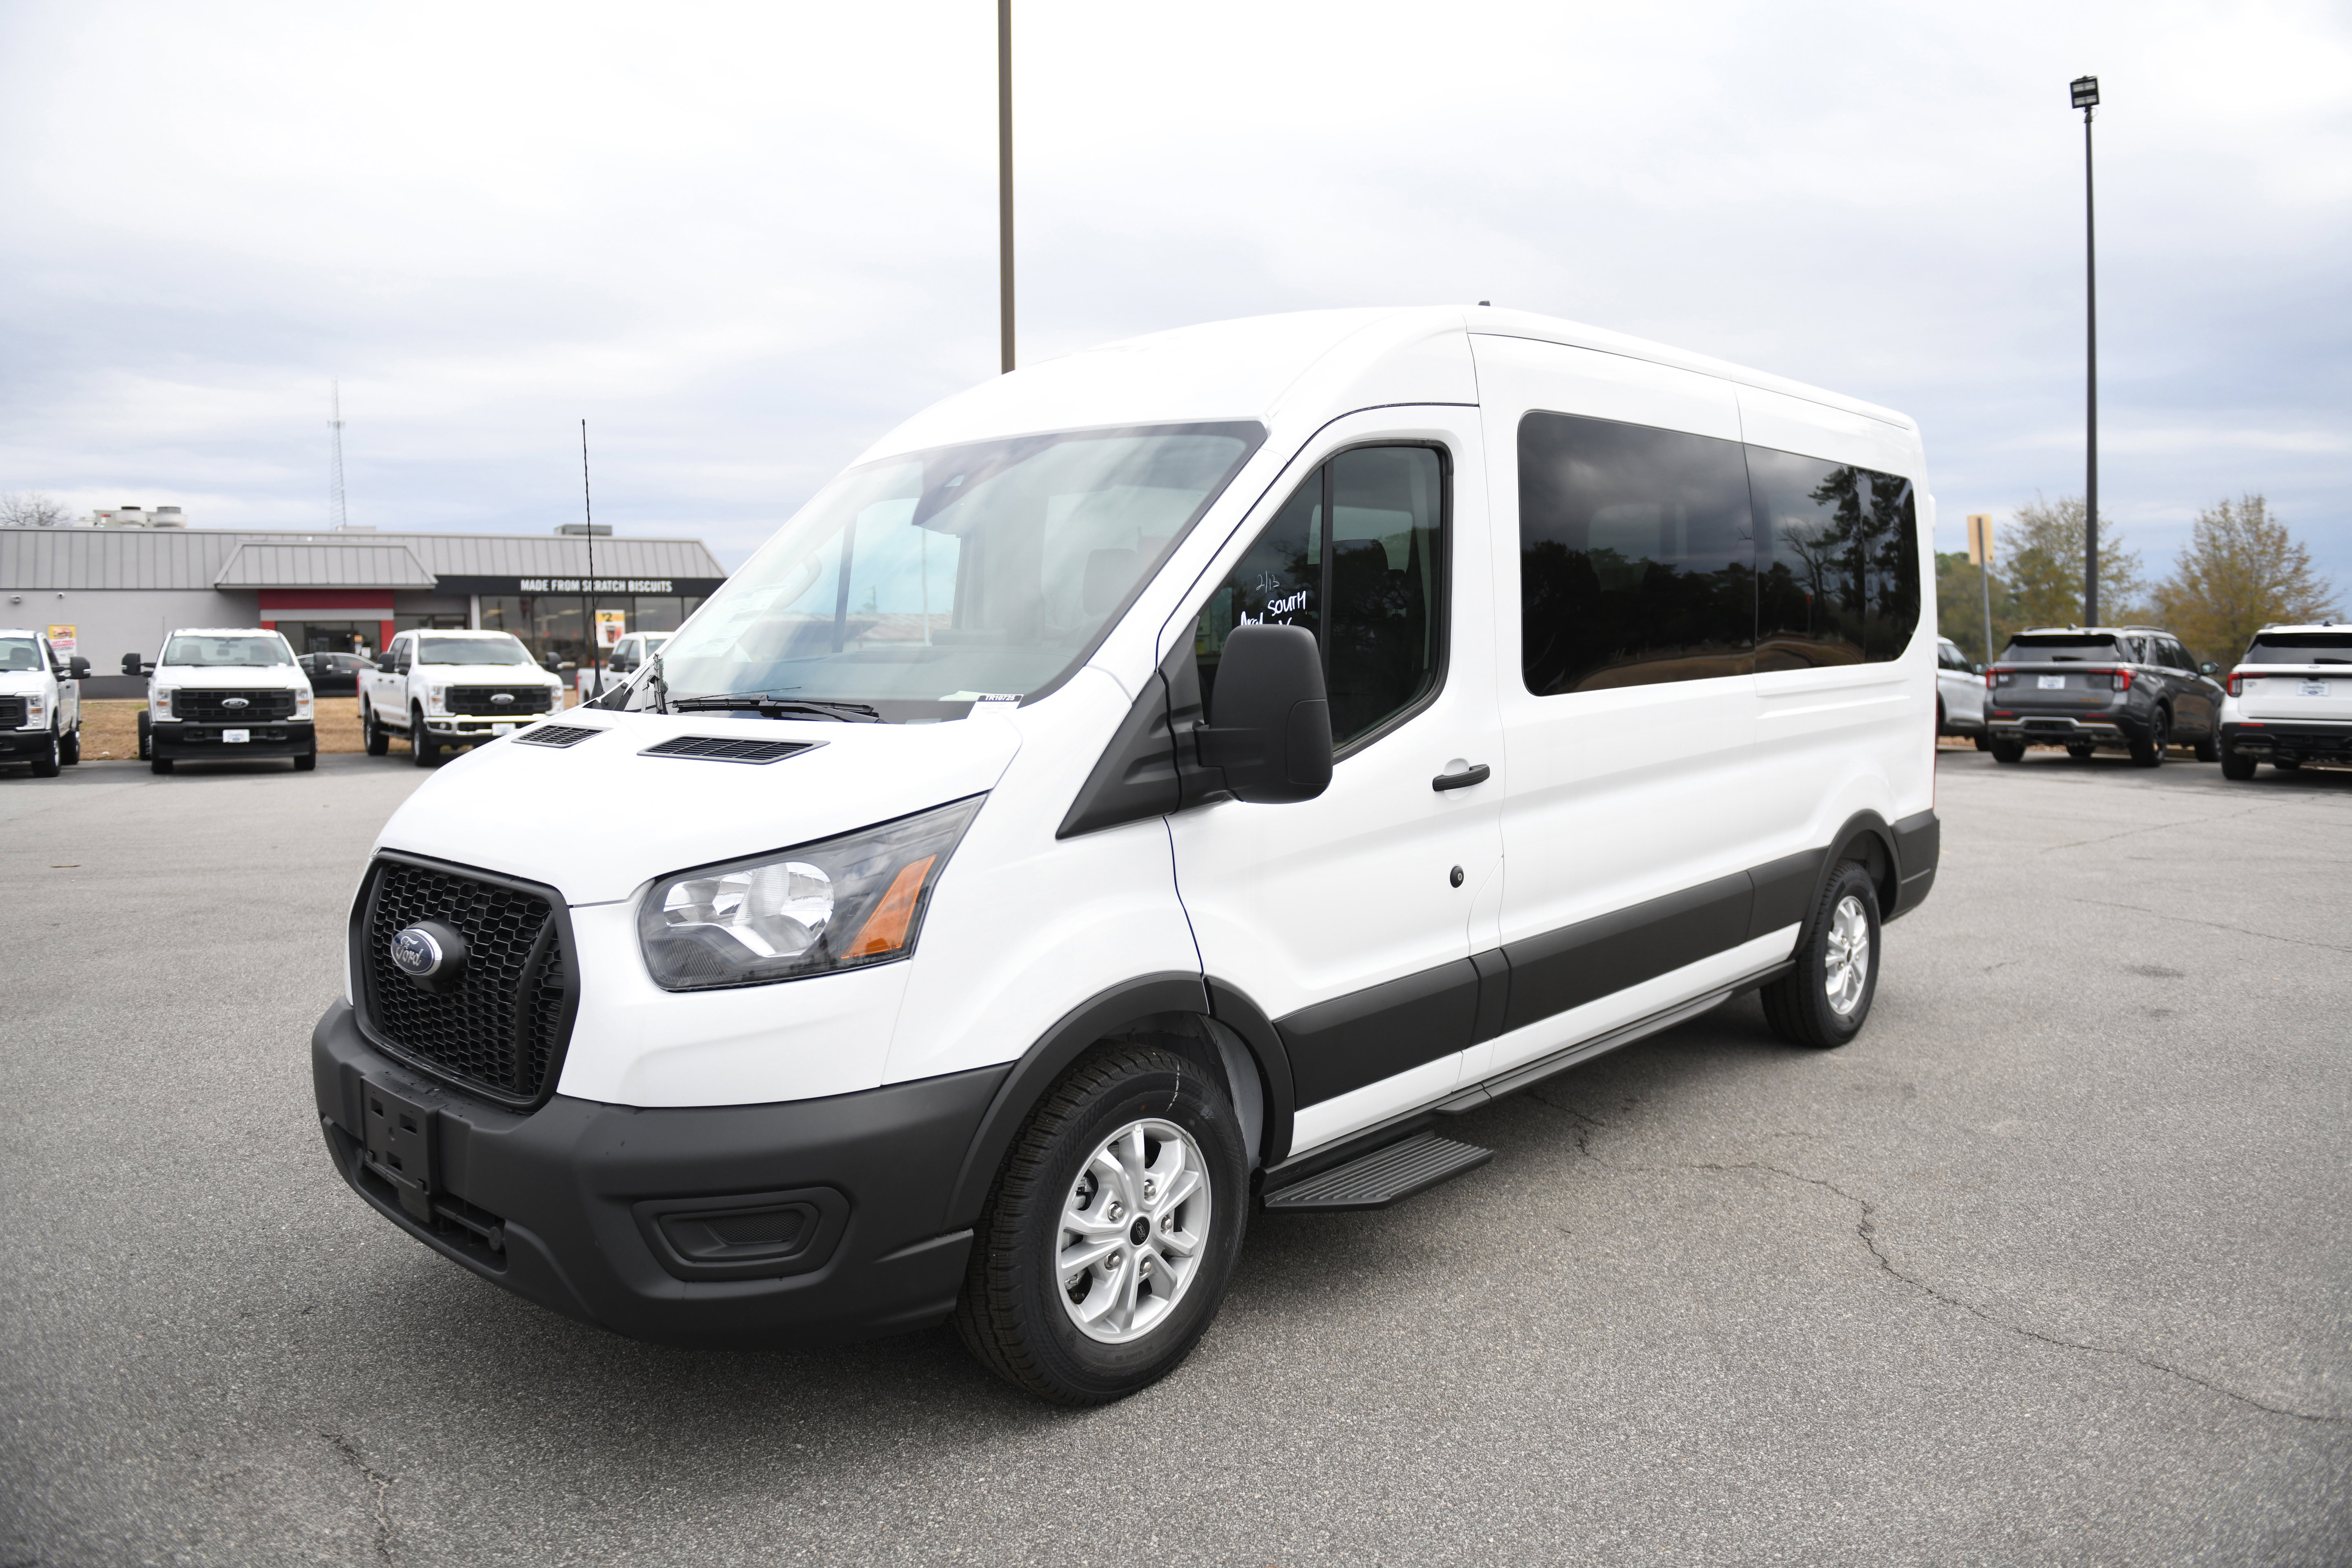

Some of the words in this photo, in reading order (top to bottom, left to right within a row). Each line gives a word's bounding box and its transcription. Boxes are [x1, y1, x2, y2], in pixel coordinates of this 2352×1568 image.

[521, 579, 550, 591] MADE
[551, 580, 580, 591] FROM
[628, 581, 673, 592] BISCUITS
[1267, 590, 1306, 616] SOUTH
[396, 935, 424, 966] Ford
